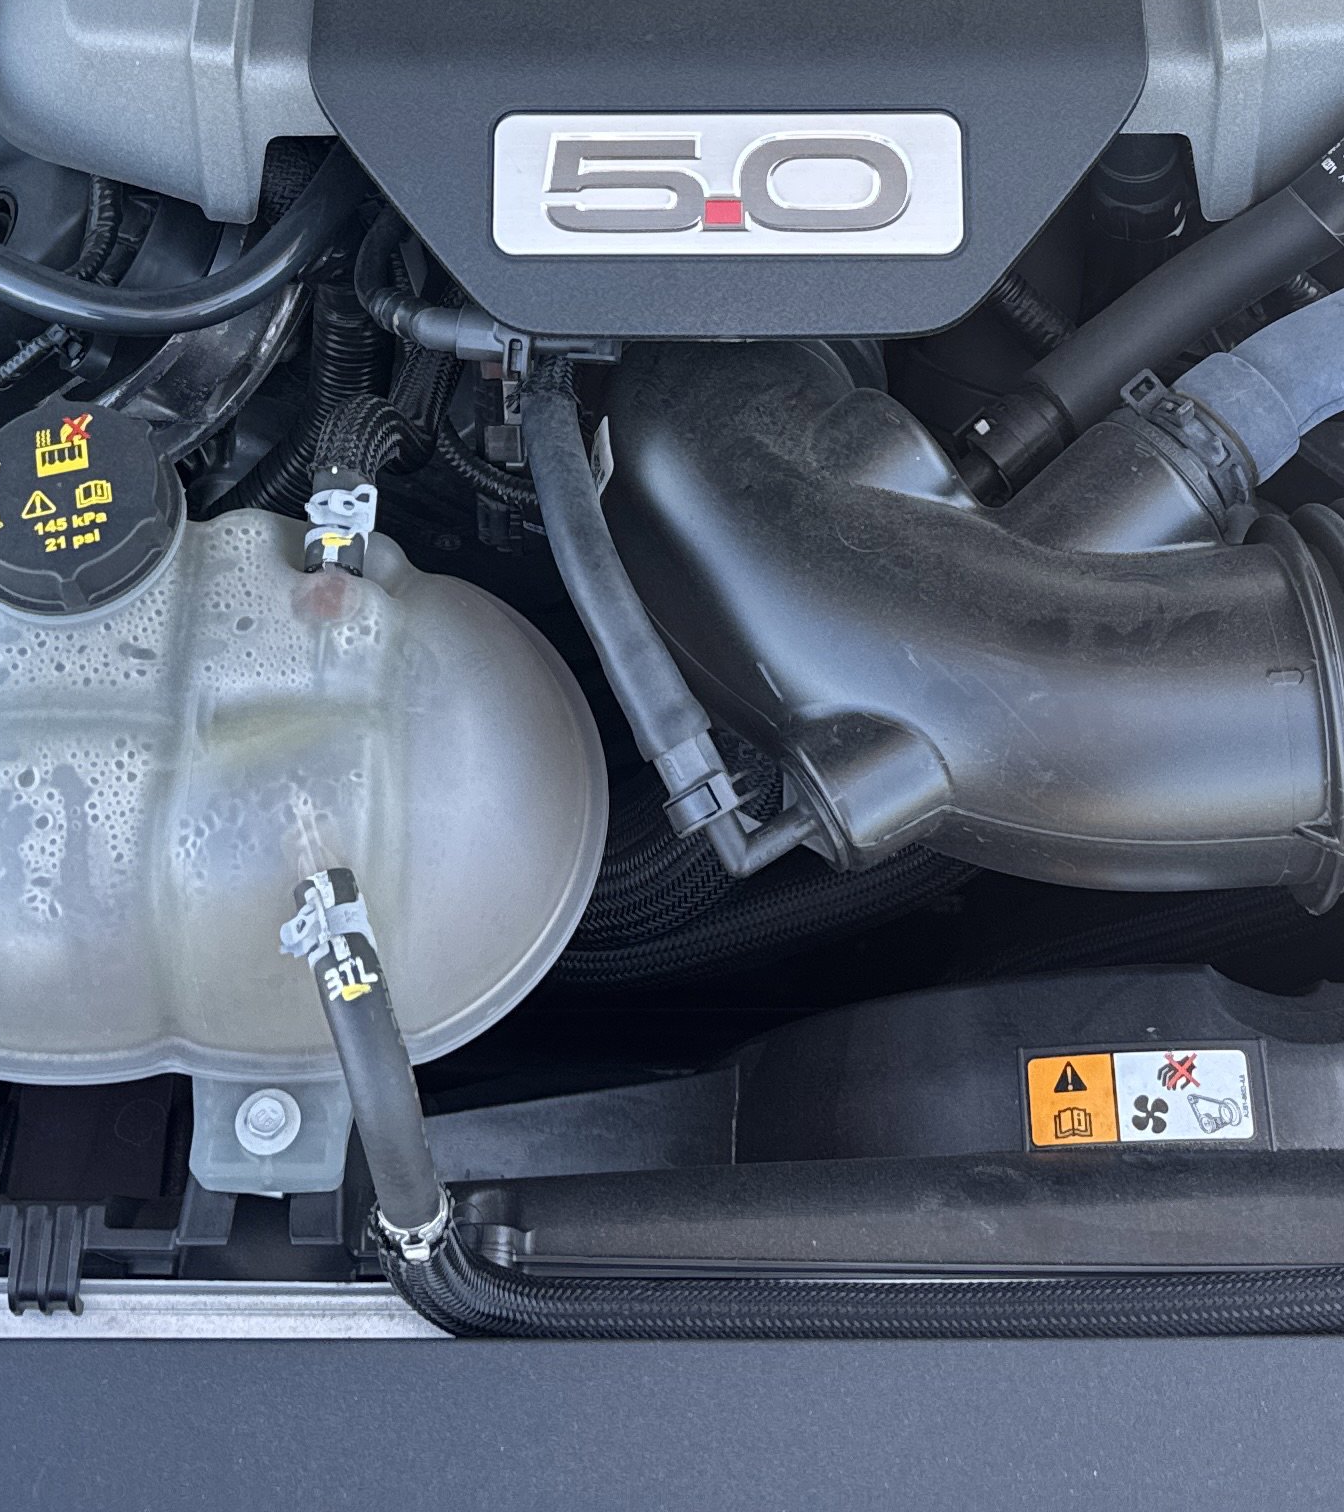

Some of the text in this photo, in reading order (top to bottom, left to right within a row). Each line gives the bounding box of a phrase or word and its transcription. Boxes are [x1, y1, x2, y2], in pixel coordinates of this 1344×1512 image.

[540, 129, 913, 234] 5.0
[33, 511, 108, 536] 145 kPa
[44, 528, 101, 553] 21 psi
